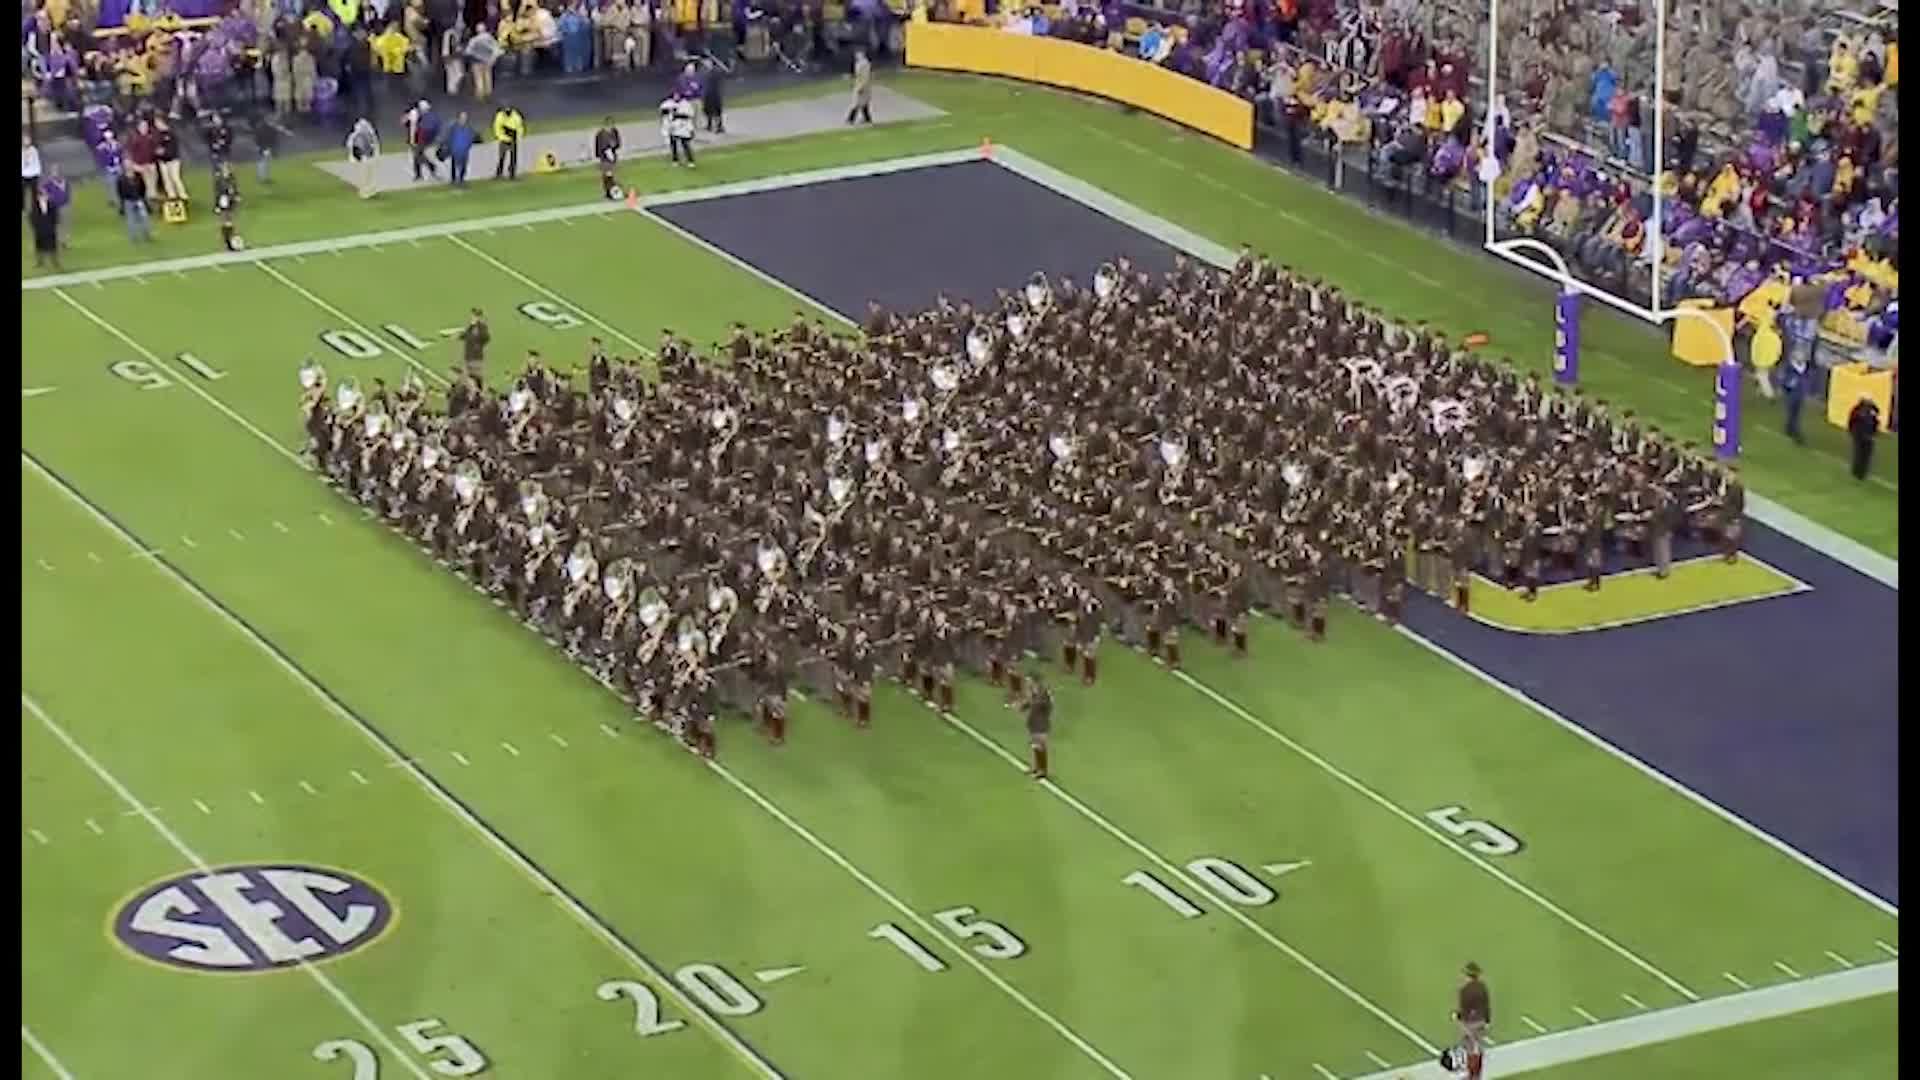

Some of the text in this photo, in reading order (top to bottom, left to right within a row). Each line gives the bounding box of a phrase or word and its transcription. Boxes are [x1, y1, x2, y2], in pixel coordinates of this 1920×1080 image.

[519, 301, 584, 330] 5
[1425, 805, 1521, 856] 5
[129, 869, 377, 967] SEC
[1121, 857, 1276, 918] 10
[867, 906, 1026, 973] 15
[598, 962, 763, 1036] 20
